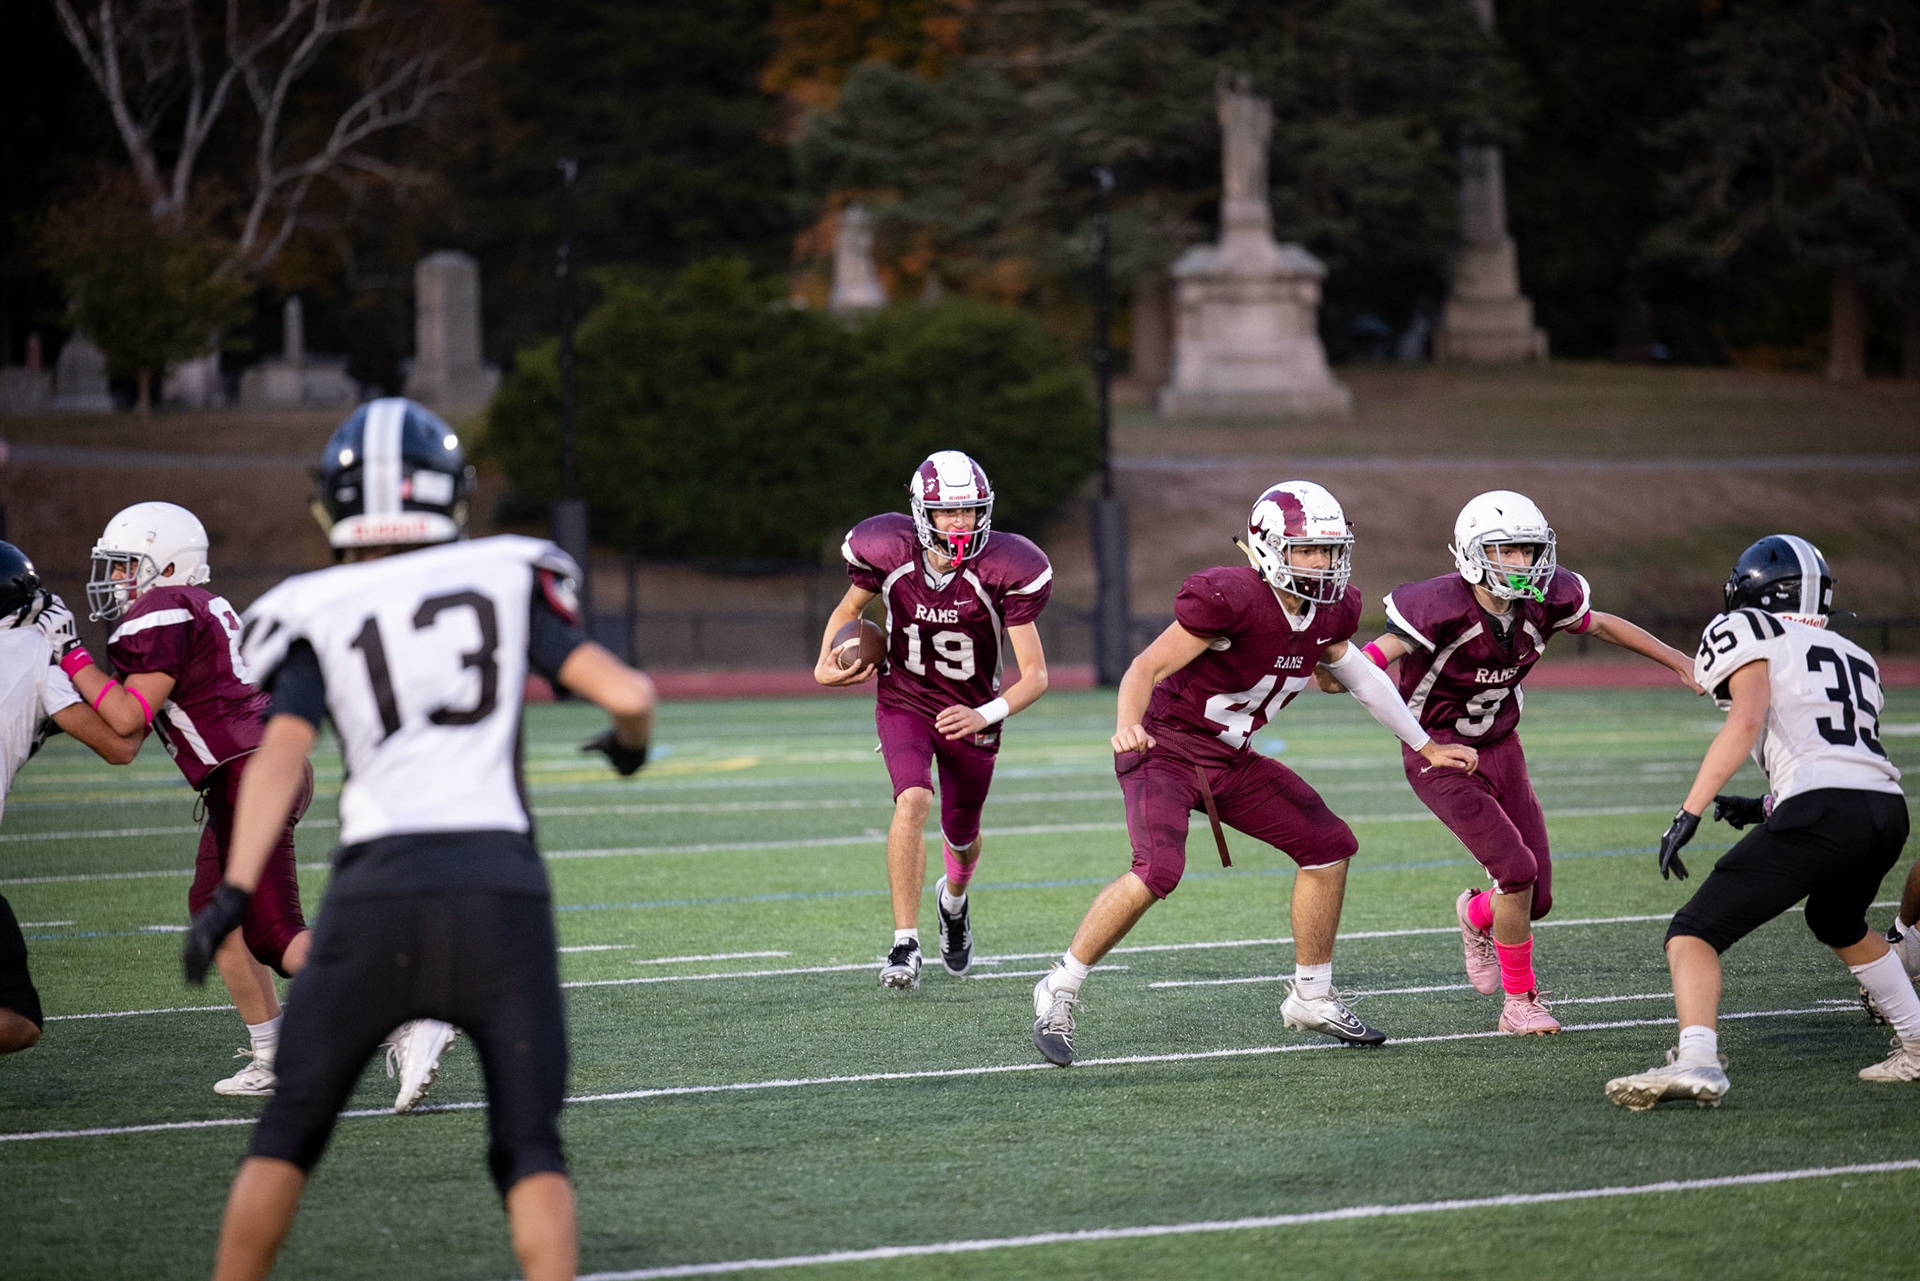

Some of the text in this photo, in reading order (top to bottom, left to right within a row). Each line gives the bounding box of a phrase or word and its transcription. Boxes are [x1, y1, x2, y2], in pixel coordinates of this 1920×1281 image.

[914, 603, 959, 624] RAMS
[1782, 615, 1826, 628] ddell
[350, 587, 499, 745] 13
[902, 623, 976, 681] 19
[1273, 655, 1304, 669] RAMS
[1699, 617, 1738, 672] 35
[1474, 665, 1520, 684] RAMS
[1454, 687, 1511, 737] 9
[1806, 645, 1888, 760] 35
